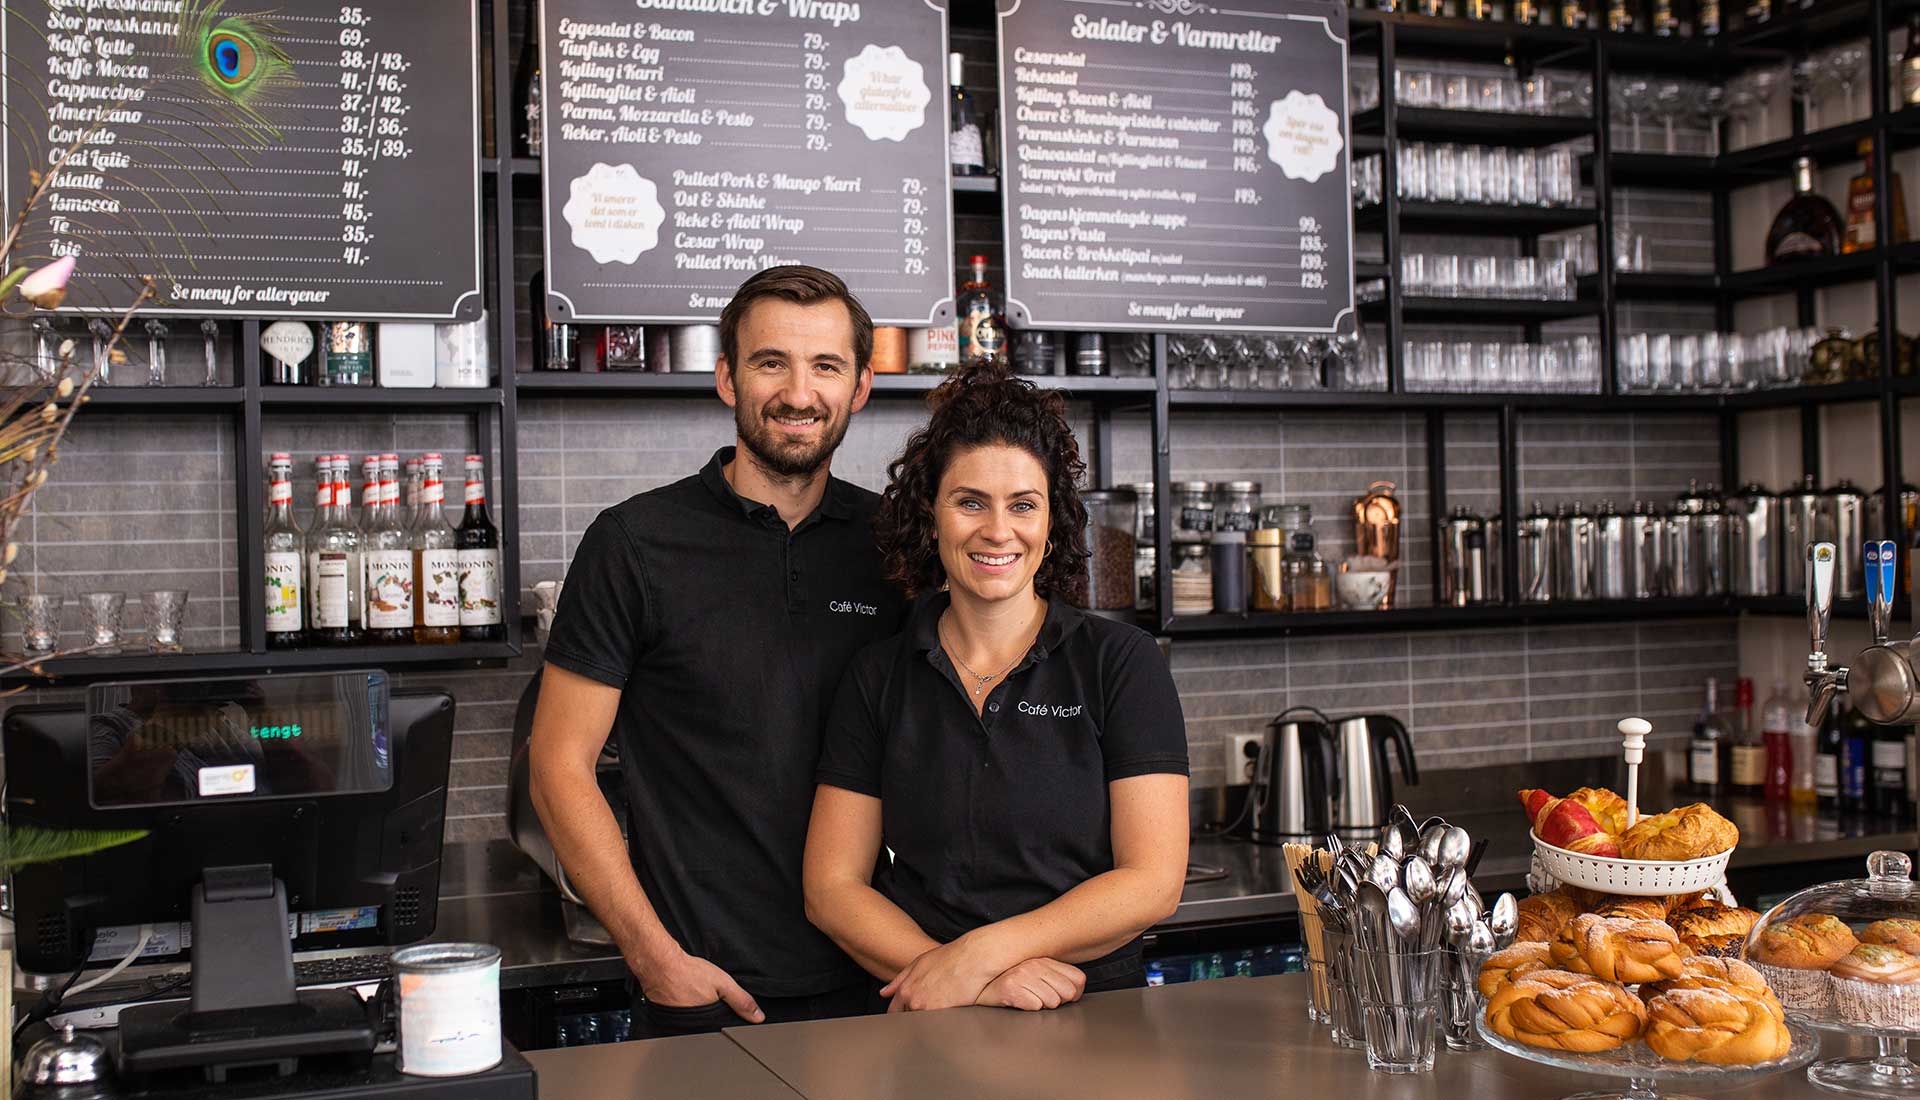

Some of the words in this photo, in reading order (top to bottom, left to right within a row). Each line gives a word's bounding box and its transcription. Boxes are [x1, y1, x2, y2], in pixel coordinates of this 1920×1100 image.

[339, 7, 371, 27] 35,-
[782, 0, 861, 27] Wraps
[47, 12, 84, 30] Stor
[85, 16, 182, 36] presskanne
[339, 28, 370, 48] 69,-
[558, 17, 631, 40] Eggesalat
[633, 22, 648, 39] &
[648, 23, 695, 42] Bacon
[803, 32, 830, 51] 79,-
[1071, 13, 1148, 43] Salater
[1150, 20, 1169, 44] &
[1171, 21, 1281, 53] Varmretter
[47, 33, 92, 57] Kaffe
[95, 36, 135, 59] Latte
[381, 52, 411, 72] 43,-
[559, 38, 615, 61] Tunfisk
[616, 42, 631, 58] &
[631, 43, 661, 65] Egg
[804, 53, 831, 71] 79,-
[47, 55, 93, 80] Kaffe
[95, 58, 149, 79] Mocca
[376, 74, 407, 93] 46,-
[559, 59, 615, 82] Kylling
[616, 63, 623, 79] i
[623, 65, 664, 82] Karri
[804, 73, 831, 91] 79,-
[48, 78, 146, 102] Cappuccino
[380, 95, 411, 115] 42,-
[560, 80, 642, 105] Kyllingfilet
[644, 85, 658, 101] &
[660, 87, 696, 104] Aioli
[805, 93, 831, 111] 79,-
[1067, 89, 1108, 107] Bacon
[1108, 91, 1120, 108] &
[48, 102, 143, 124] Americano
[377, 117, 408, 137] 36,-
[561, 101, 616, 123] Parma,
[619, 105, 699, 125] Mozzarella
[700, 108, 714, 125] &
[715, 109, 755, 128] Pesto
[805, 113, 832, 132] 79,-
[1060, 107, 1072, 124] &
[48, 124, 116, 145] Cortado
[382, 139, 413, 159] 39,-
[561, 123, 609, 143] Reker,
[611, 127, 647, 144] Aioli
[648, 127, 661, 143] &
[663, 127, 703, 146] Pesto
[806, 134, 833, 152] 79,-
[1103, 129, 1116, 145] &
[48, 147, 88, 166] Chai
[89, 149, 130, 171] Latte
[342, 159, 368, 178] 41,-
[342, 181, 368, 200] 41,-
[672, 168, 719, 189] Pulled
[720, 171, 756, 189] Pork
[756, 172, 770, 189] &
[772, 173, 822, 196] Mango
[823, 175, 861, 193] Karri
[902, 178, 928, 197] 79,-
[49, 192, 120, 213] Ismocca
[342, 203, 373, 222] 45,-
[673, 190, 700, 208] Ost
[701, 191, 715, 208] &
[716, 192, 767, 210] Skinke
[903, 198, 929, 216] 79,-
[673, 211, 709, 229] Reke
[710, 211, 725, 229] &
[726, 213, 761, 230] Aioli
[762, 214, 804, 235] Wrap
[903, 218, 929, 236] 79,-
[1019, 203, 1068, 225] Dagens
[1068, 207, 1151, 228] hjemmelagde
[1151, 213, 1187, 230] suppe
[49, 215, 69, 233] Te
[342, 225, 374, 244] 35,-
[1020, 223, 1068, 244] Dagens
[1069, 226, 1107, 243] Pasta
[343, 247, 370, 266] 41,-
[722, 233, 764, 254] Wrap
[903, 238, 929, 256] 79,-
[1020, 243, 1062, 261] Bacon
[1062, 245, 1074, 261] &
[674, 253, 722, 270] Pulled
[722, 254, 758, 271] Pork
[904, 258, 930, 275] 79,-
[1022, 263, 1062, 281] Snack
[170, 283, 189, 300] Se
[190, 288, 231, 305] meny
[229, 285, 255, 305] for
[256, 286, 330, 306] allergener
[688, 293, 705, 308] Se
[706, 297, 733, 308] men
[1128, 301, 1142, 316] Se
[1143, 305, 1173, 320] meny
[1171, 302, 1190, 320] for
[1190, 303, 1245, 322] allergener
[928, 329, 956, 341] PINK
[372, 562, 409, 571] MONIN
[431, 560, 457, 569] MON
[829, 600, 853, 613] Café
[854, 601, 877, 616] Victor
[1018, 701, 1048, 716] Café
[1051, 703, 1082, 718] Victor
